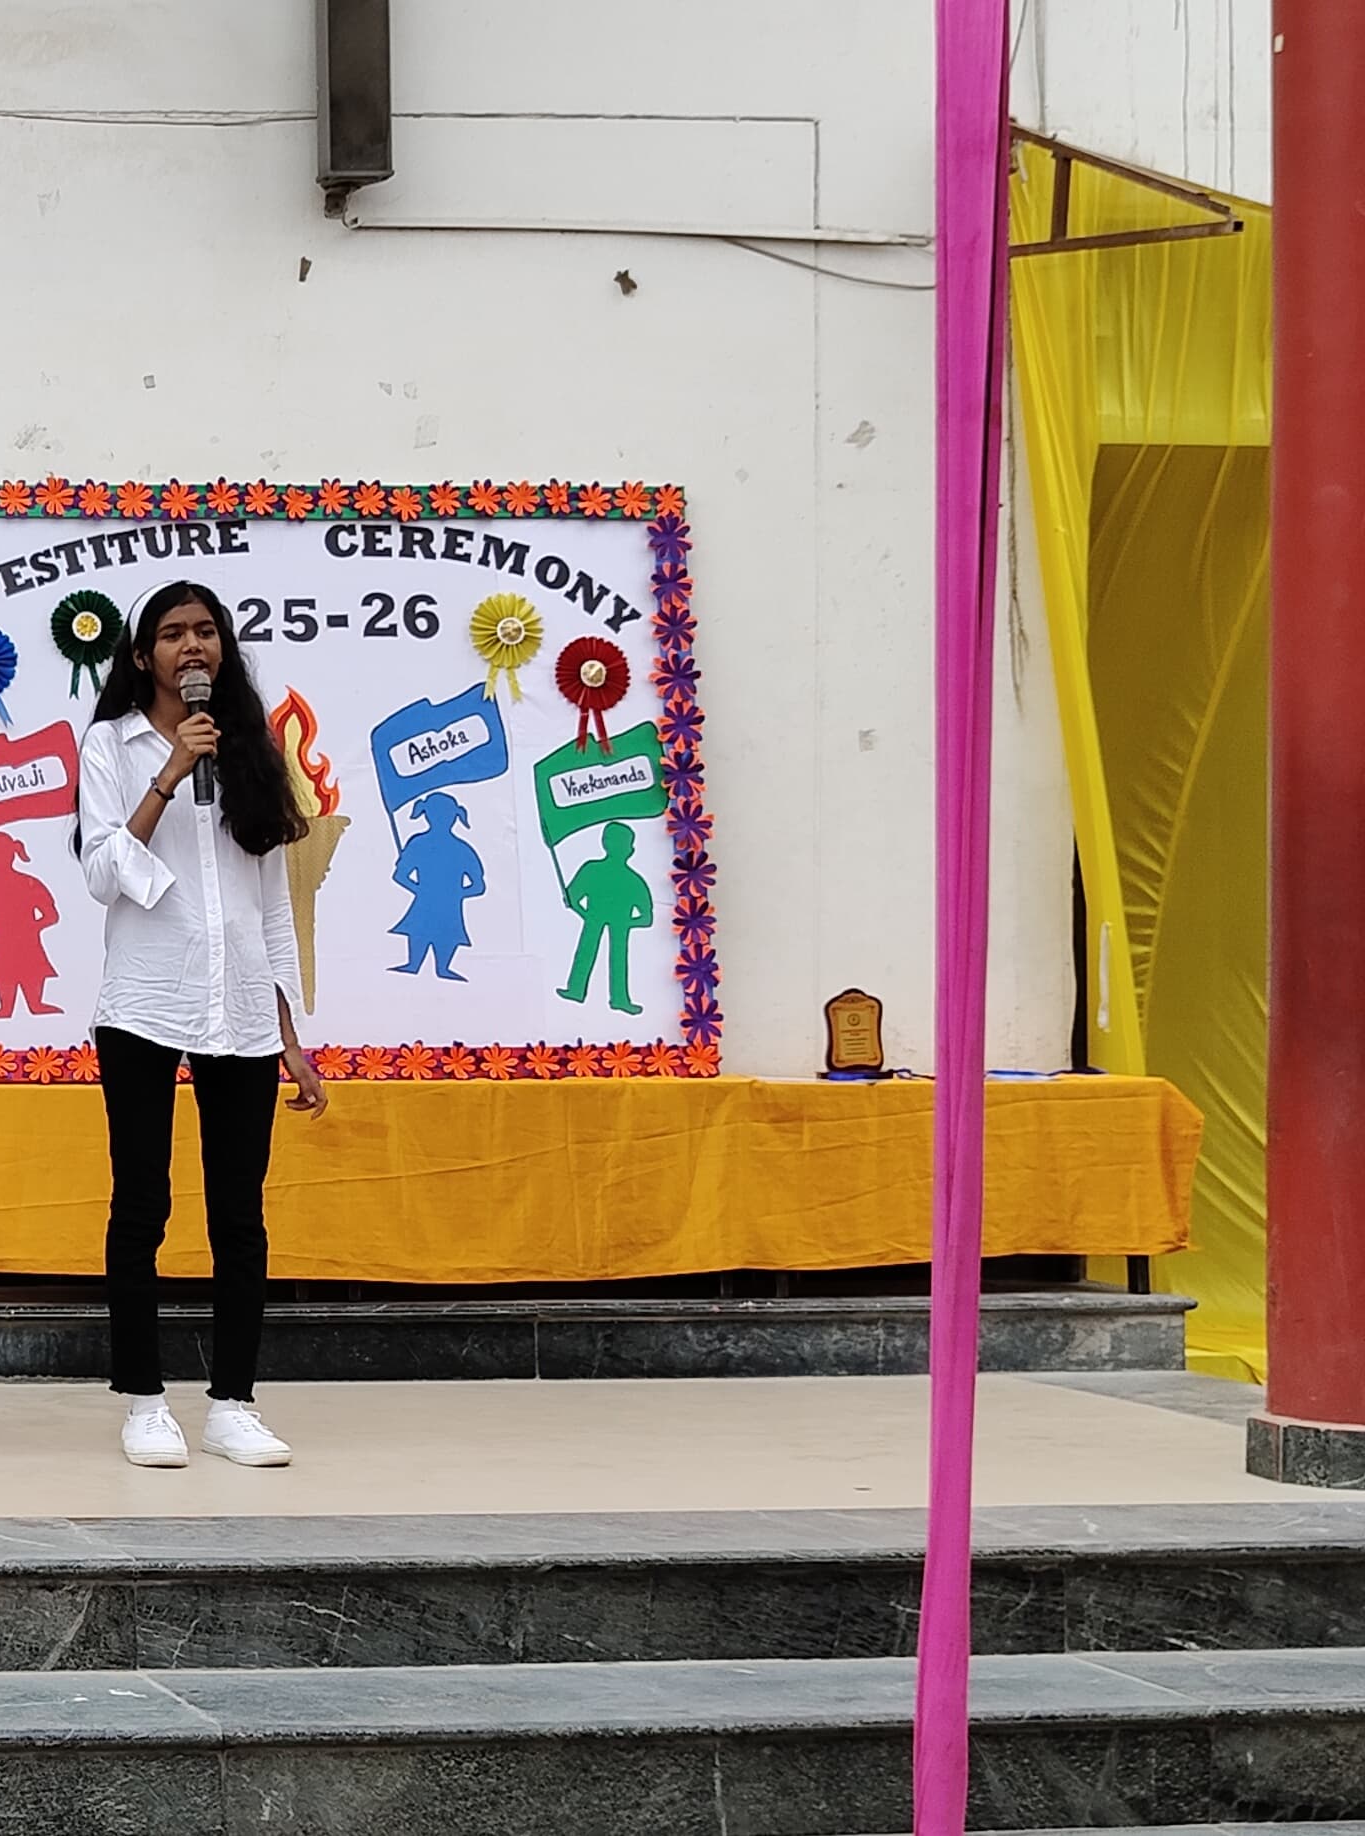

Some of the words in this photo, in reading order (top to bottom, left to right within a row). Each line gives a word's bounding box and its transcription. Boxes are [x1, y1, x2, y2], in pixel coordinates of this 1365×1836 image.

[324, 523, 642, 635] CEREMONY
[220, 592, 441, 643] 25-26
[408, 730, 470, 765] Ashoka
[560, 765, 648, 797] Vivekananda
